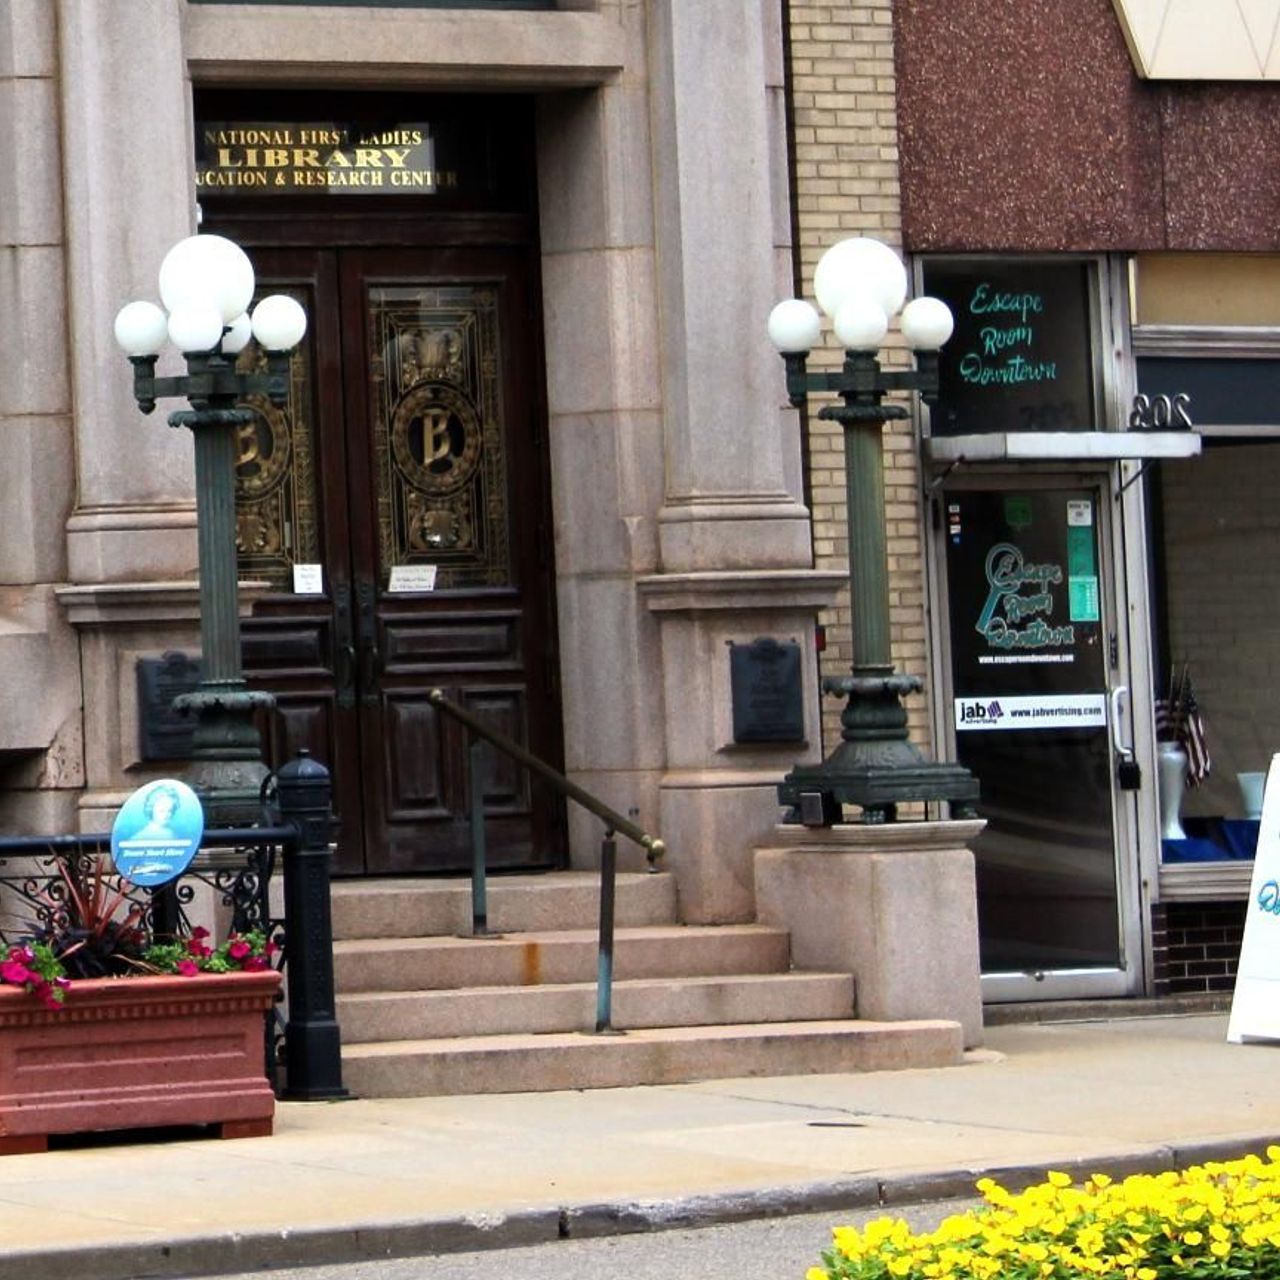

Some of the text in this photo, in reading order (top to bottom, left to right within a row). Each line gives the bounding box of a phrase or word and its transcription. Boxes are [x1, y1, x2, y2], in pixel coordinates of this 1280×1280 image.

[204, 129, 294, 145] NATIONAL
[359, 129, 423, 145] LADIES
[217, 148, 411, 167] LIBRARY
[275, 170, 286, 186] &
[294, 170, 383, 186] RESEARCH
[969, 282, 1044, 323] Escape
[980, 325, 1033, 357] Room
[959, 353, 1057, 385] Downtown
[422, 408, 452, 465] B
[993, 554, 1063, 594] Escape
[1003, 593, 1053, 624] Room
[984, 616, 1075, 649] Downtown
[960, 701, 1102, 722] jab www.jabvertising.com
